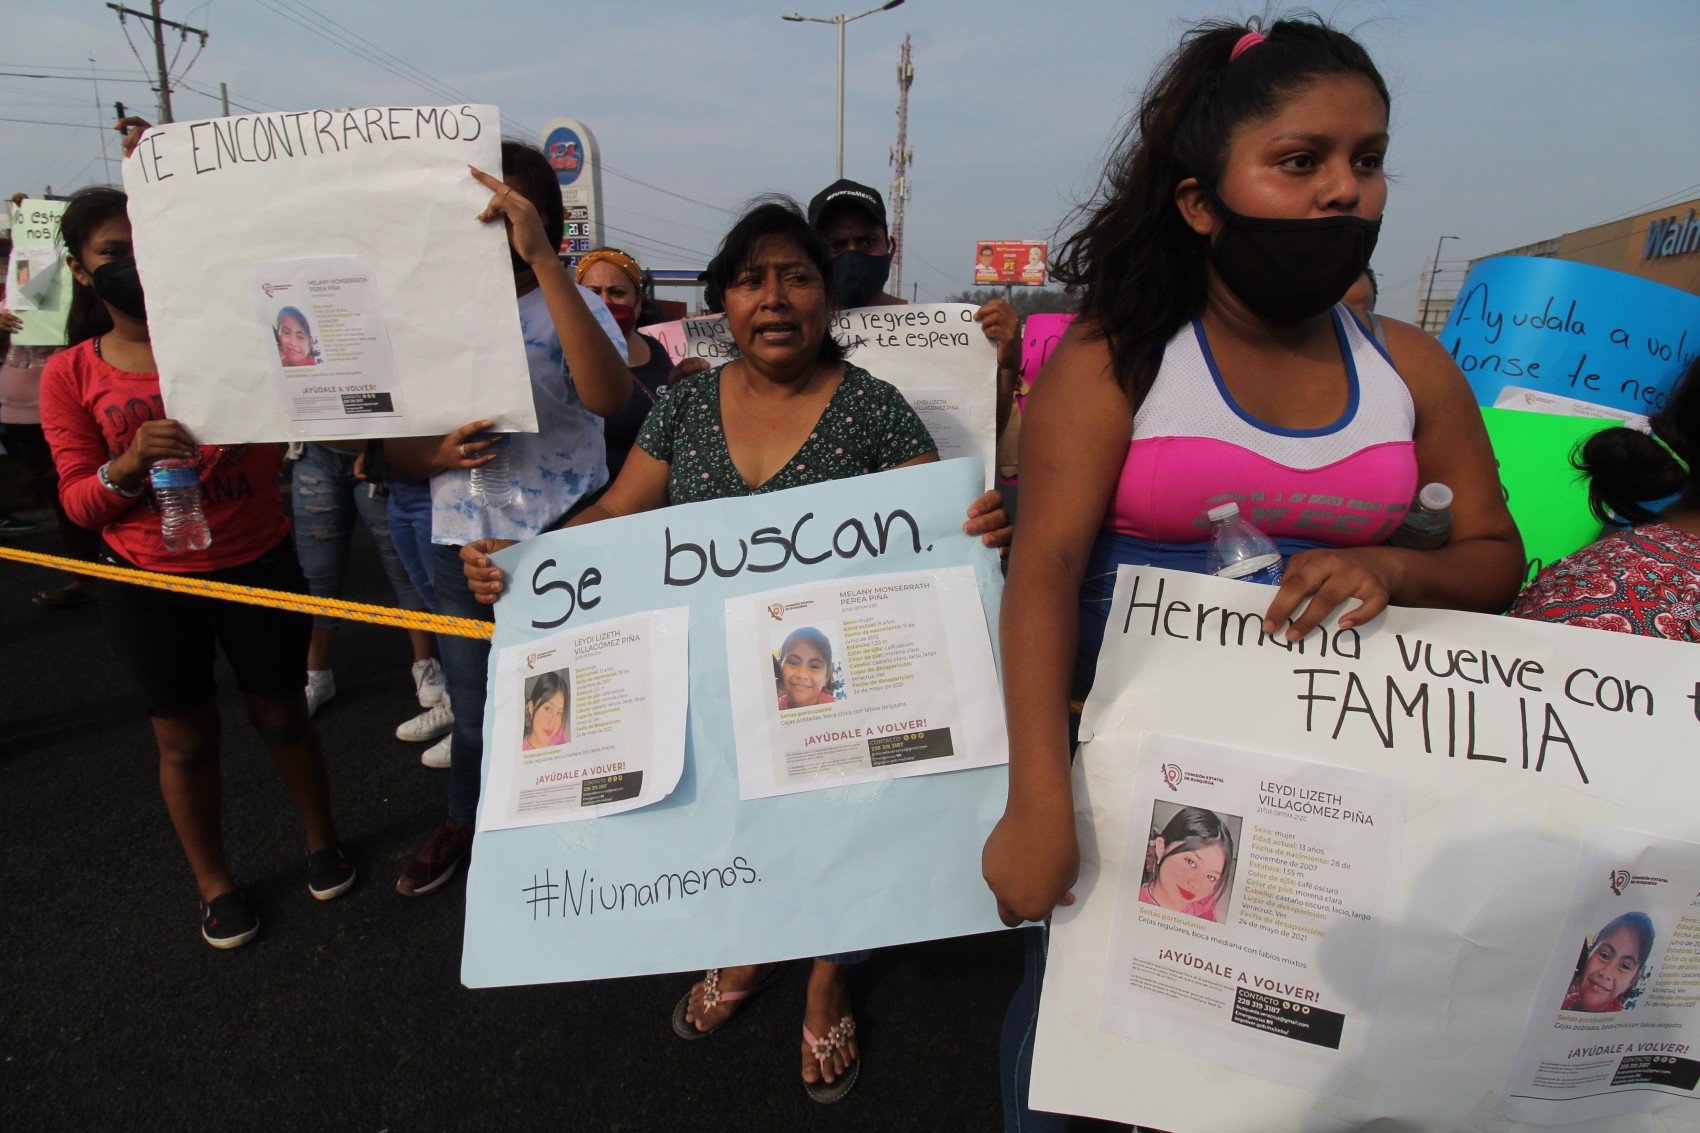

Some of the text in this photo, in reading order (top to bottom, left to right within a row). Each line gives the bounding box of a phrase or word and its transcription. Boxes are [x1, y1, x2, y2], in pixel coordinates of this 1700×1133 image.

[136, 105, 481, 183] TE ENCONTRAREMOS
[1004, 262, 1015, 270] PT
[961, 310, 972, 322] a
[686, 321, 725, 337] Hija
[1610, 328, 1629, 349] a
[877, 333, 900, 347] te
[906, 331, 969, 348] espera
[1568, 354, 1600, 390] te
[302, 386, 336, 394] ¡AYÚDALE
[345, 384, 377, 392] VOLVER!
[532, 559, 602, 629] Se
[839, 582, 930, 599] MELANY MONSERRATH
[840, 593, 888, 606] PEREA PIÑA
[574, 630, 621, 647] LEYDI LIZETH
[574, 633, 640, 655] VILLAGÓMEZ PIÑA
[872, 650, 937, 666] castaño largo
[1396, 634, 1544, 693] vuelve
[1564, 668, 1654, 716] con
[869, 685, 884, 693] mayo
[781, 704, 881, 726] Cejas boca chica labios
[804, 718, 928, 747] ¡AYÚDALE A VOLVER!
[1293, 668, 1589, 784] FAMILIA
[870, 736, 900, 746] CONTACTO
[536, 762, 626, 785] ¡AYÚDALE A VOLVER!
[1260, 781, 1342, 806] LEYDI LIZETH
[1259, 794, 1374, 826] VILLAGÓMEZ PIÑA
[1274, 830, 1295, 840] mujer
[1252, 835, 1271, 844] Edad
[1272, 838, 1298, 849] actual:
[1307, 846, 1324, 855] años
[1250, 852, 1288, 866] noviembre
[1300, 863, 1317, 871] 2007
[1252, 844, 1273, 853] Fecha
[1286, 851, 1330, 865] nacimiento:
[1330, 859, 1340, 867] 28
[1341, 861, 1351, 869] de
[1249, 861, 1282, 873] Estatura:
[1246, 879, 1266, 887] Color
[1295, 889, 1323, 900] morena
[1324, 896, 1342, 905] clara
[1248, 870, 1267, 879] Color
[1297, 881, 1313, 890] café
[1314, 885, 1339, 895] oscuro
[1243, 895, 1265, 906] Lugar
[1245, 886, 1275, 899] Cabello:
[1275, 894, 1304, 906] castaño
[1305, 901, 1331, 912] oscuro,
[1352, 912, 1372, 922] largo
[1139, 907, 1207, 932] Señas particulares:
[1240, 910, 1262, 921] Fecha
[1138, 915, 1156, 927] Cejas
[1192, 930, 1209, 942] boca
[1210, 935, 1242, 951] mediana
[1243, 945, 1257, 955] con
[1258, 948, 1281, 962] labios
[1281, 956, 1308, 969] mixtos.
[1259, 924, 1279, 935] mayo
[1280, 929, 1290, 937] de
[1291, 932, 1307, 942] 2021
[1159, 949, 1233, 979] ¡AYÚDALE
[1237, 972, 1248, 984] A
[1253, 975, 1320, 1003] VOLVER!
[1237, 997, 1281, 1014] 228 319 3187
[1238, 989, 1280, 1006] CONTACTO
[1567, 1043, 1690, 1059] ¡AYÚDALE A VOLVER!
